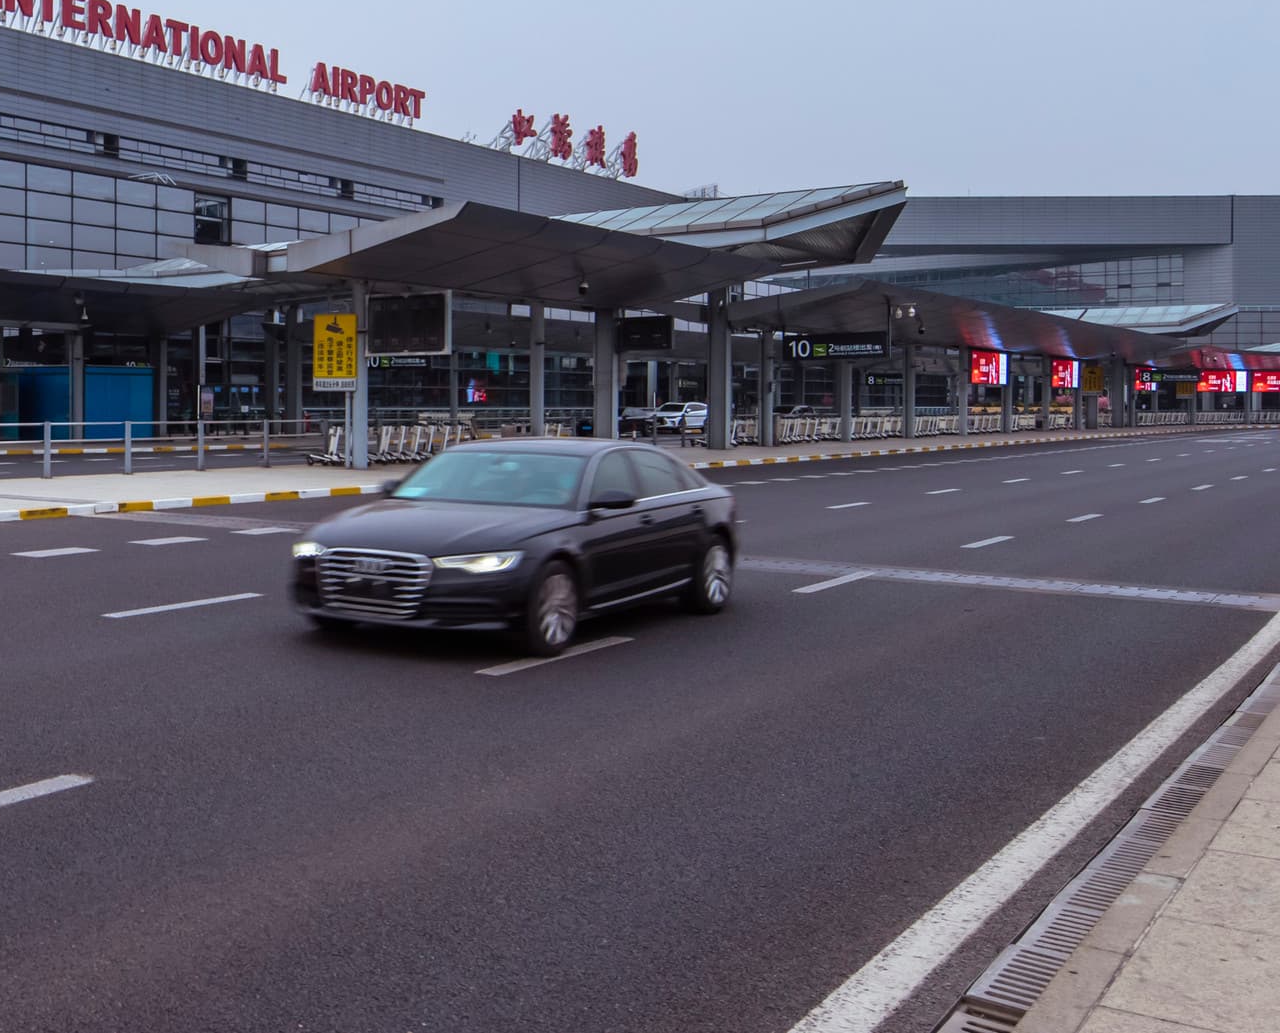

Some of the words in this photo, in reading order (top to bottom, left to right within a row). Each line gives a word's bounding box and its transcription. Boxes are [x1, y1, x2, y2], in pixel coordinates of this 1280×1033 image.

[312, 62, 425, 119] AIRPORT
[789, 340, 810, 357] 10
[868, 377, 875, 385] 8
[1142, 372, 1151, 381] 8
